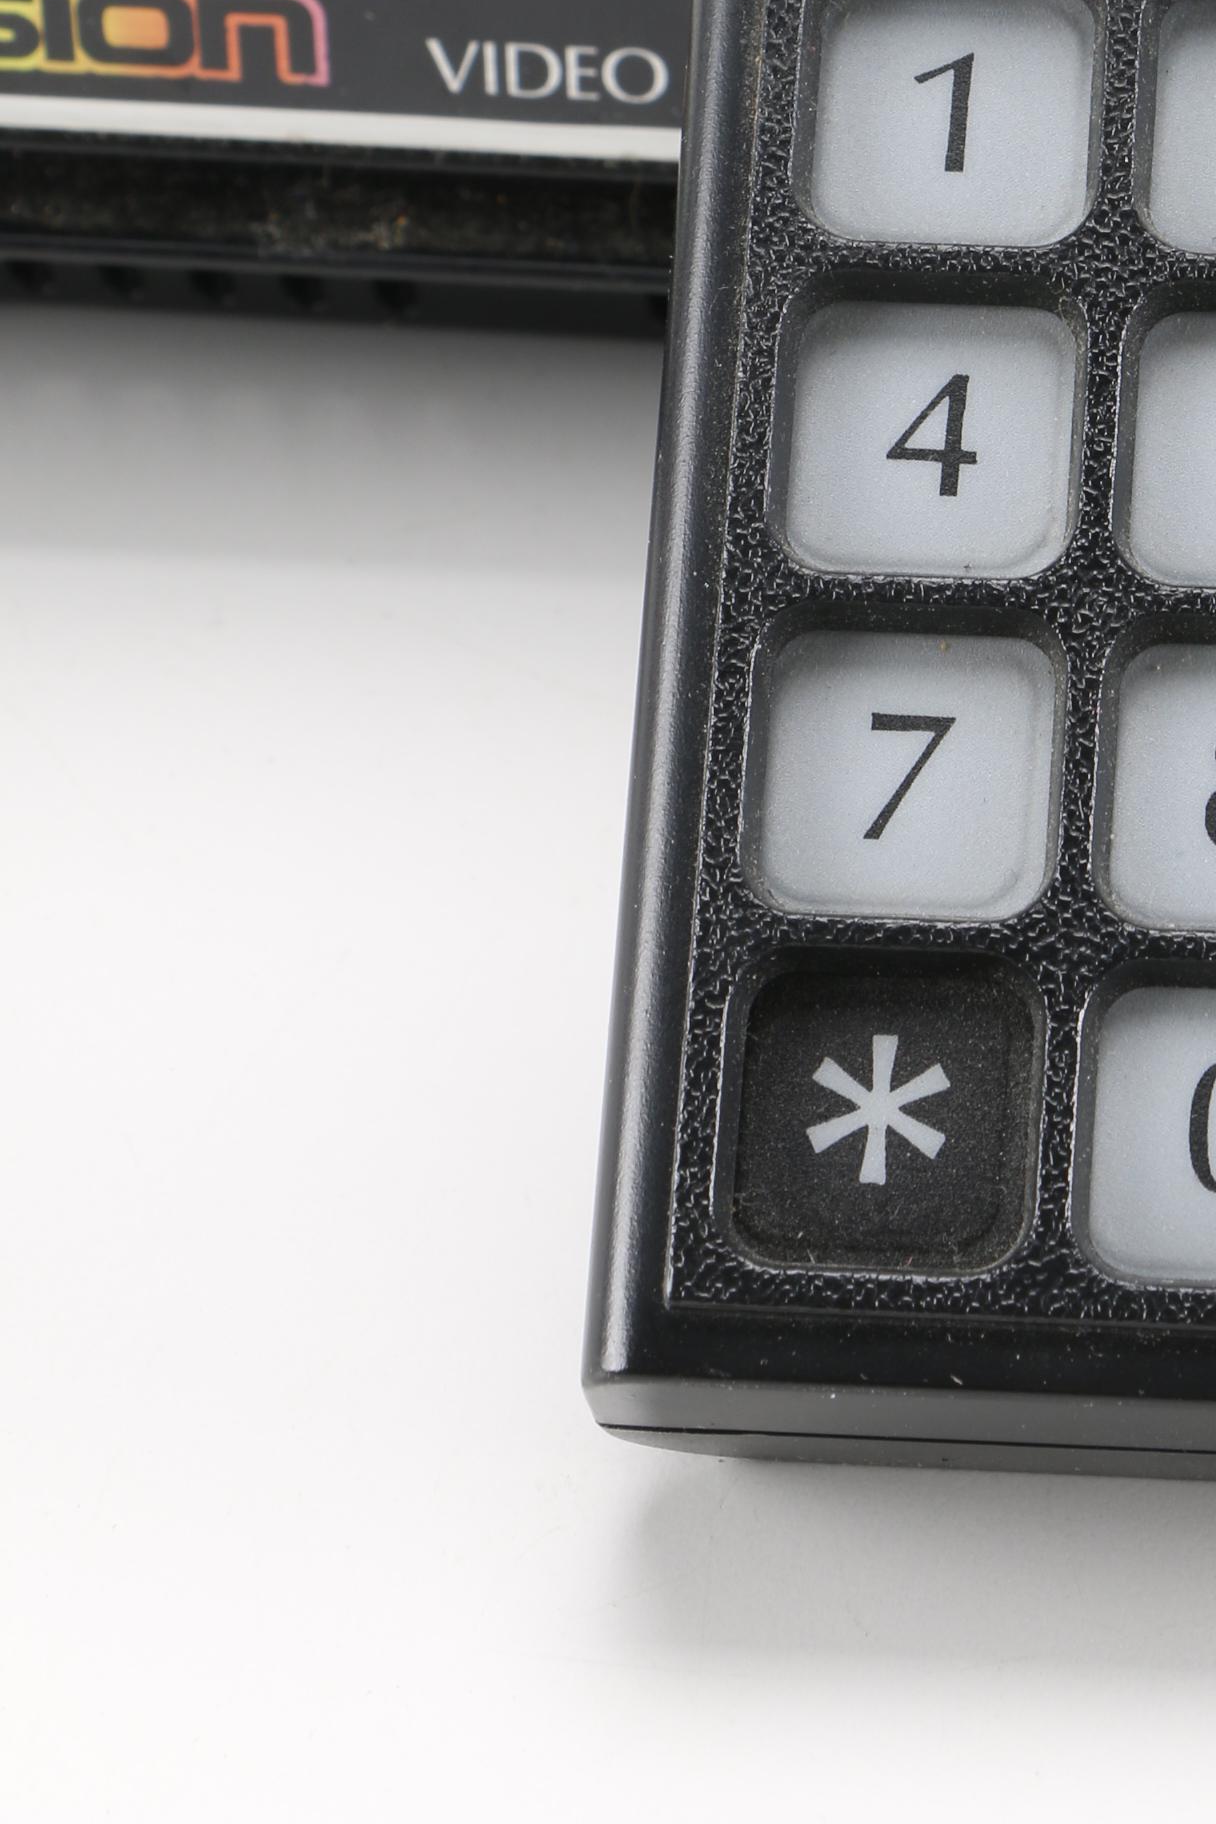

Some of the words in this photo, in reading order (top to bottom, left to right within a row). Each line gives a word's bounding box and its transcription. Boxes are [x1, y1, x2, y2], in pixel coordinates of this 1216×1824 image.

[424, 37, 669, 105] VIDEO
[915, 53, 974, 171] 1
[887, 374, 977, 496] 4
[863, 713, 956, 839] 7
